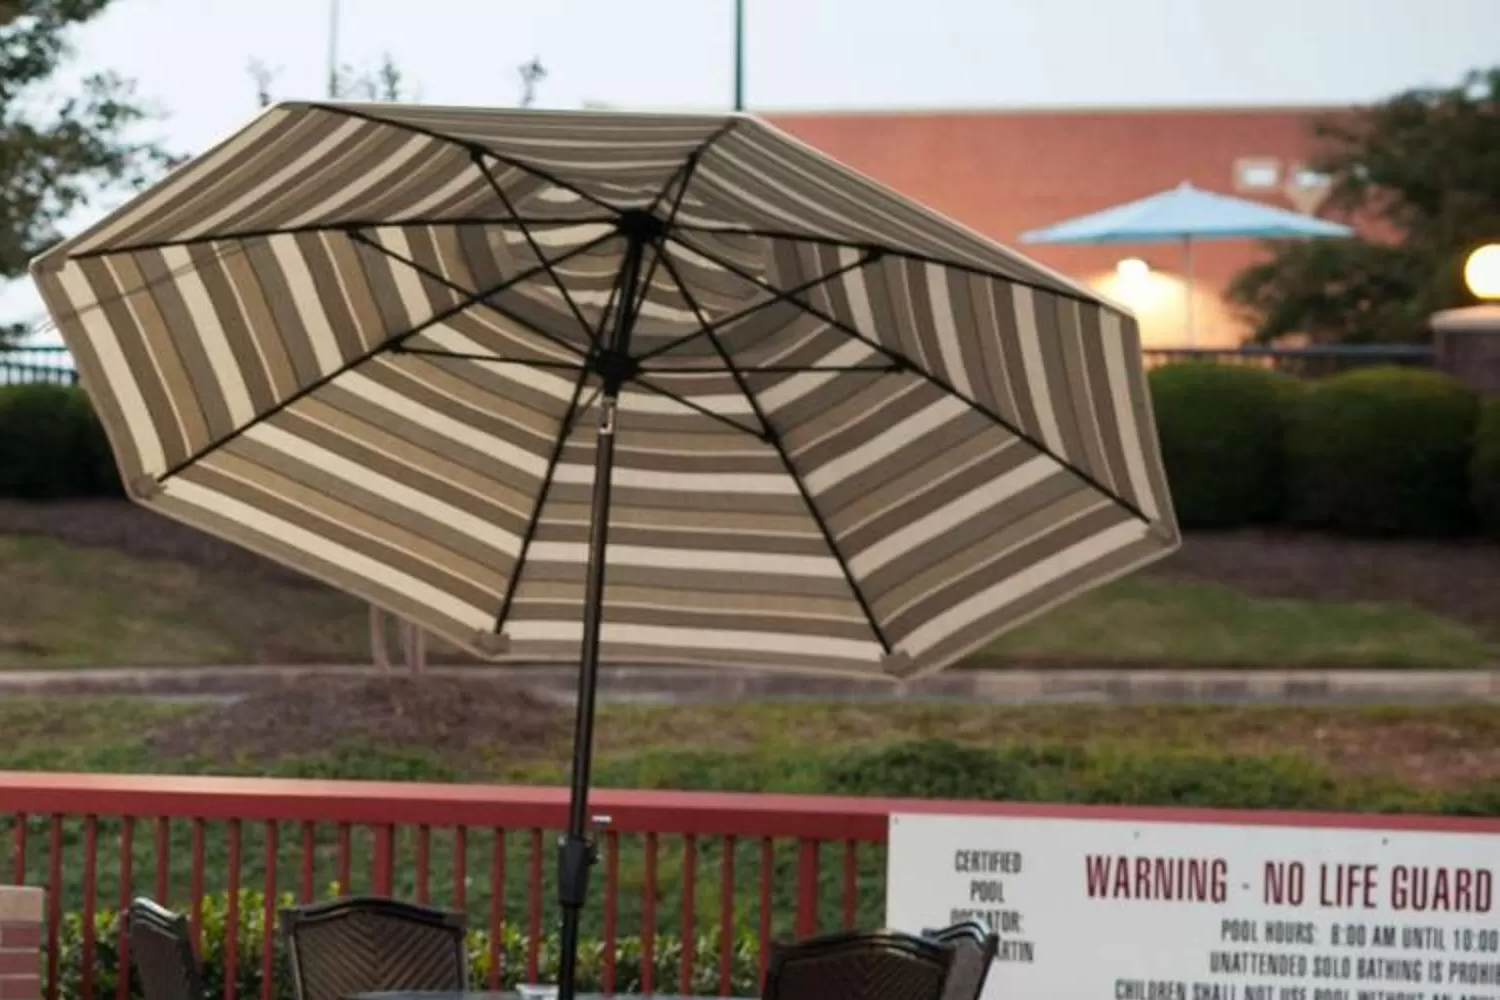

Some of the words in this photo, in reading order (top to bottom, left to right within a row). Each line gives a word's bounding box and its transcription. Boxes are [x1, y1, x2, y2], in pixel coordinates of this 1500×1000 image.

[955, 850, 1022, 873] CERTIFIED
[970, 880, 1004, 903] POOL
[1086, 855, 1227, 904] WARNING
[1264, 861, 1304, 907] NO
[1320, 863, 1377, 908] LIFE
[1391, 864, 1492, 913] GUARD
[1221, 919, 1257, 942] POOL
[1372, 925, 1396, 948] AM
[1402, 926, 1445, 950] UNTIL
[1210, 951, 1307, 977] UNATTENDED
[1313, 956, 1350, 979] SOLO
[1357, 957, 1422, 982] BATHING
[1428, 961, 1442, 982] IS
